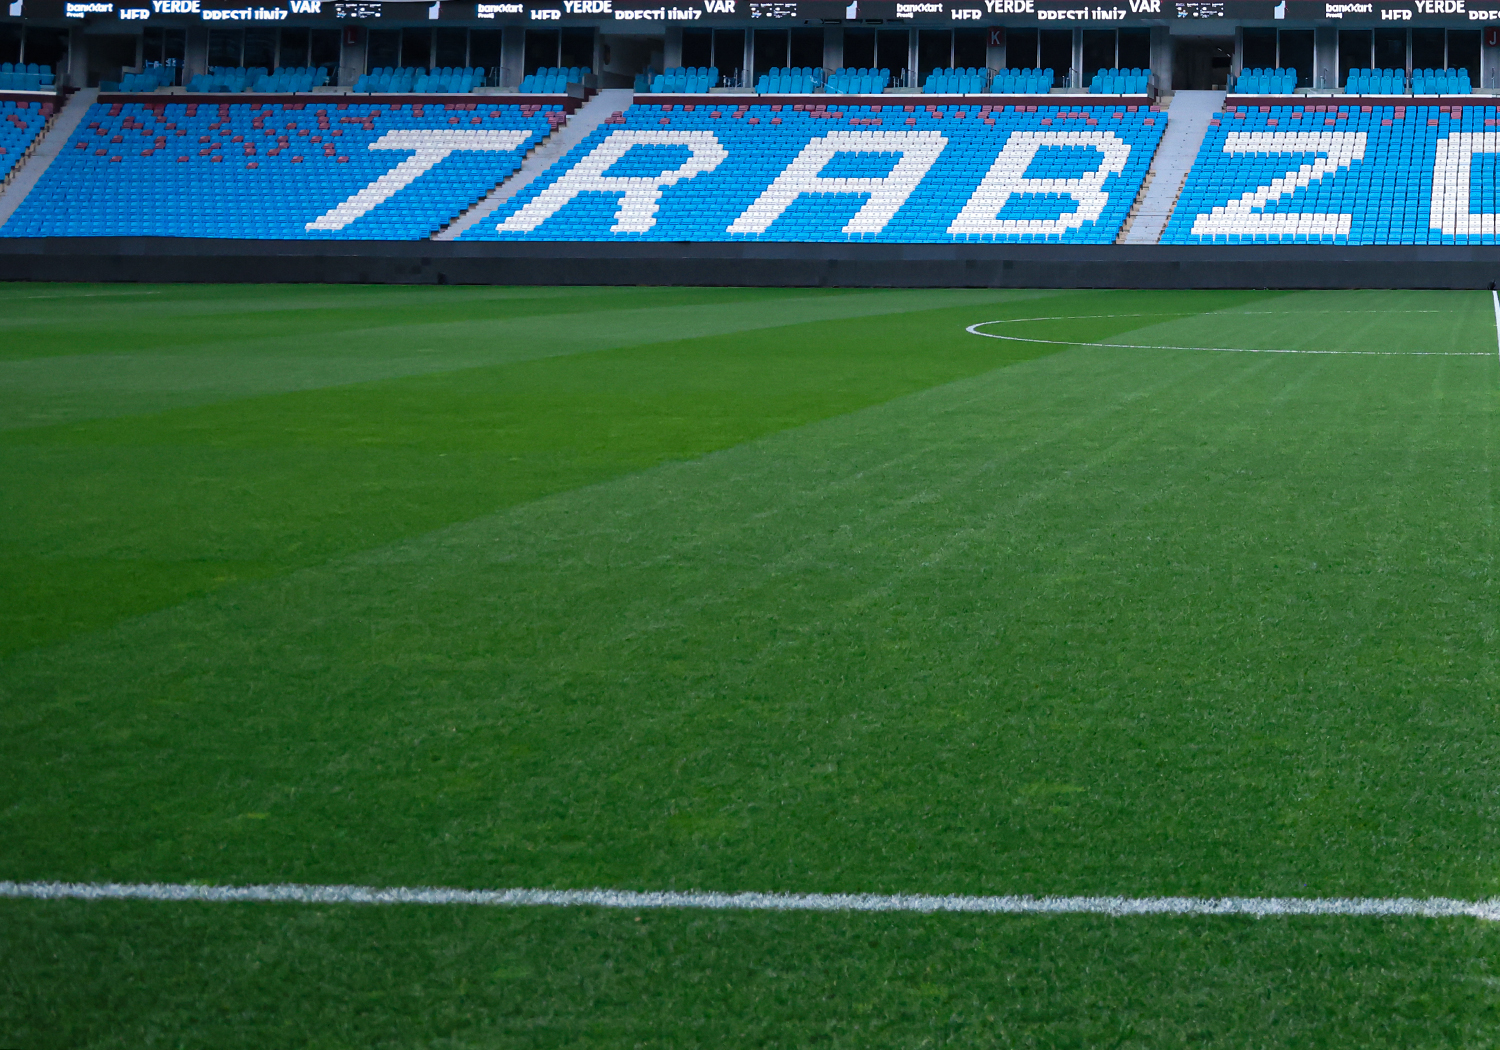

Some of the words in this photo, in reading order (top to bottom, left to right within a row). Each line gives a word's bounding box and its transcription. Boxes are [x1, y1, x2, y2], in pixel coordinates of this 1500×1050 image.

[152, 0, 201, 13] YERDE
[290, 0, 321, 14] VAR
[563, 0, 613, 13] YERDE
[703, 0, 736, 13] VAR
[984, 0, 1035, 13] YERDE
[1129, 0, 1161, 13] VAR
[1414, 0, 1466, 14] YERDE
[991, 31, 1000, 45] K
[1489, 31, 1497, 45] J
